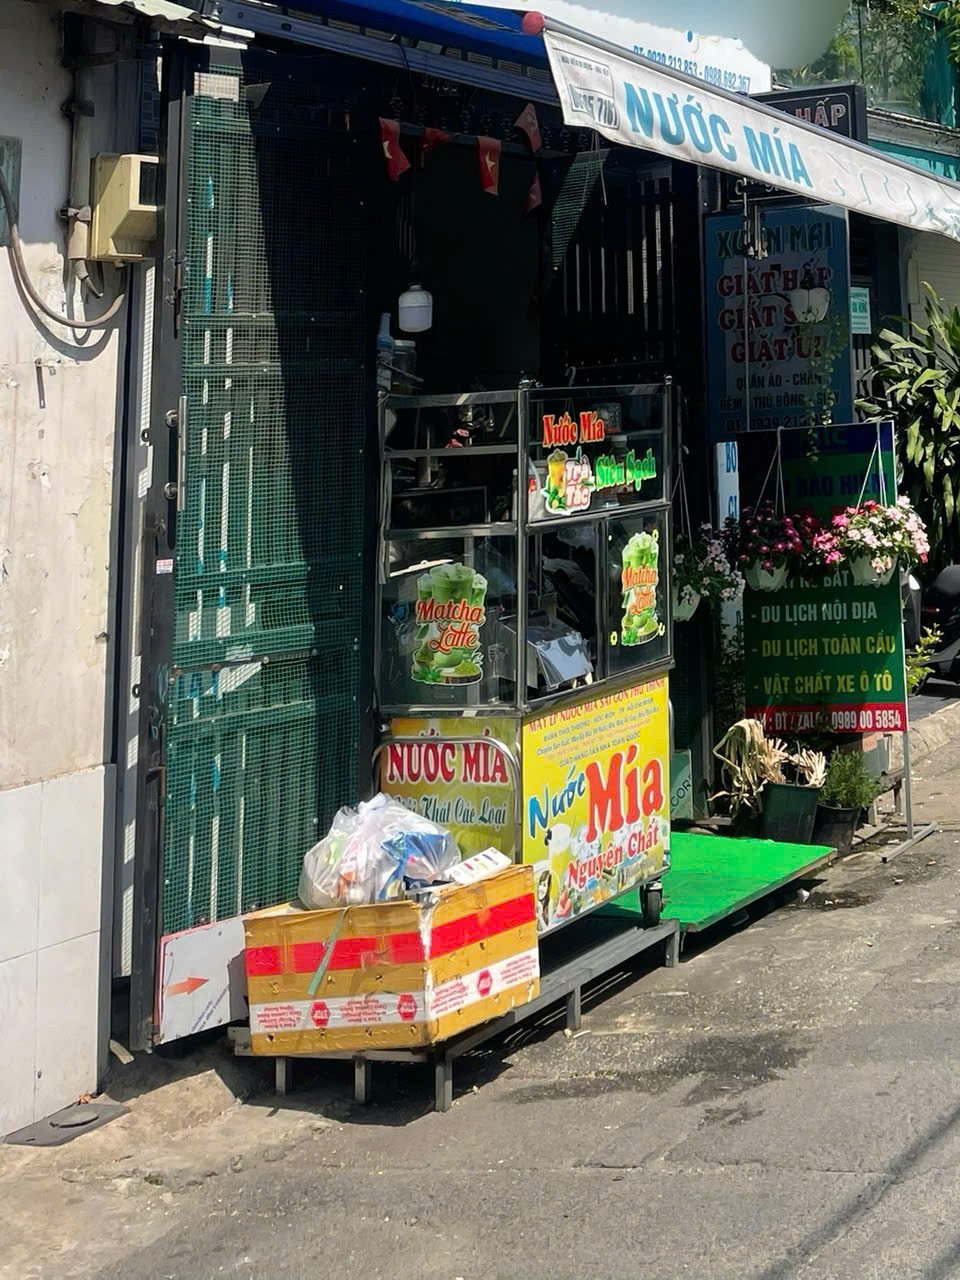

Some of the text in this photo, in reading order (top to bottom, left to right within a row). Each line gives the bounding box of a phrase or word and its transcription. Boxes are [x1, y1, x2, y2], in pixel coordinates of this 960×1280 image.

[623, 80, 737, 162] NƯỚC
[743, 127, 813, 188] MÍA
[715, 226, 784, 257] XUN
[543, 411, 605, 448] Nước Mía
[596, 448, 656, 491] Siêu Sạch
[623, 566, 658, 589] Matcha
[416, 598, 486, 624] Matcha
[761, 599, 878, 626] DU LỊCH NỘI ĐỊA
[429, 621, 480, 654] Latte
[761, 629, 896, 660] DU LỊCH TOÀN CẦU
[763, 668, 893, 698] VẬT CHẤT XE Ô TÔ
[831, 710, 857, 730] 0989
[859, 710, 873, 729] 00
[875, 709, 901, 728] 5854
[528, 743, 664, 843] Nước Mía
[567, 818, 660, 890] Nguyên Chất
